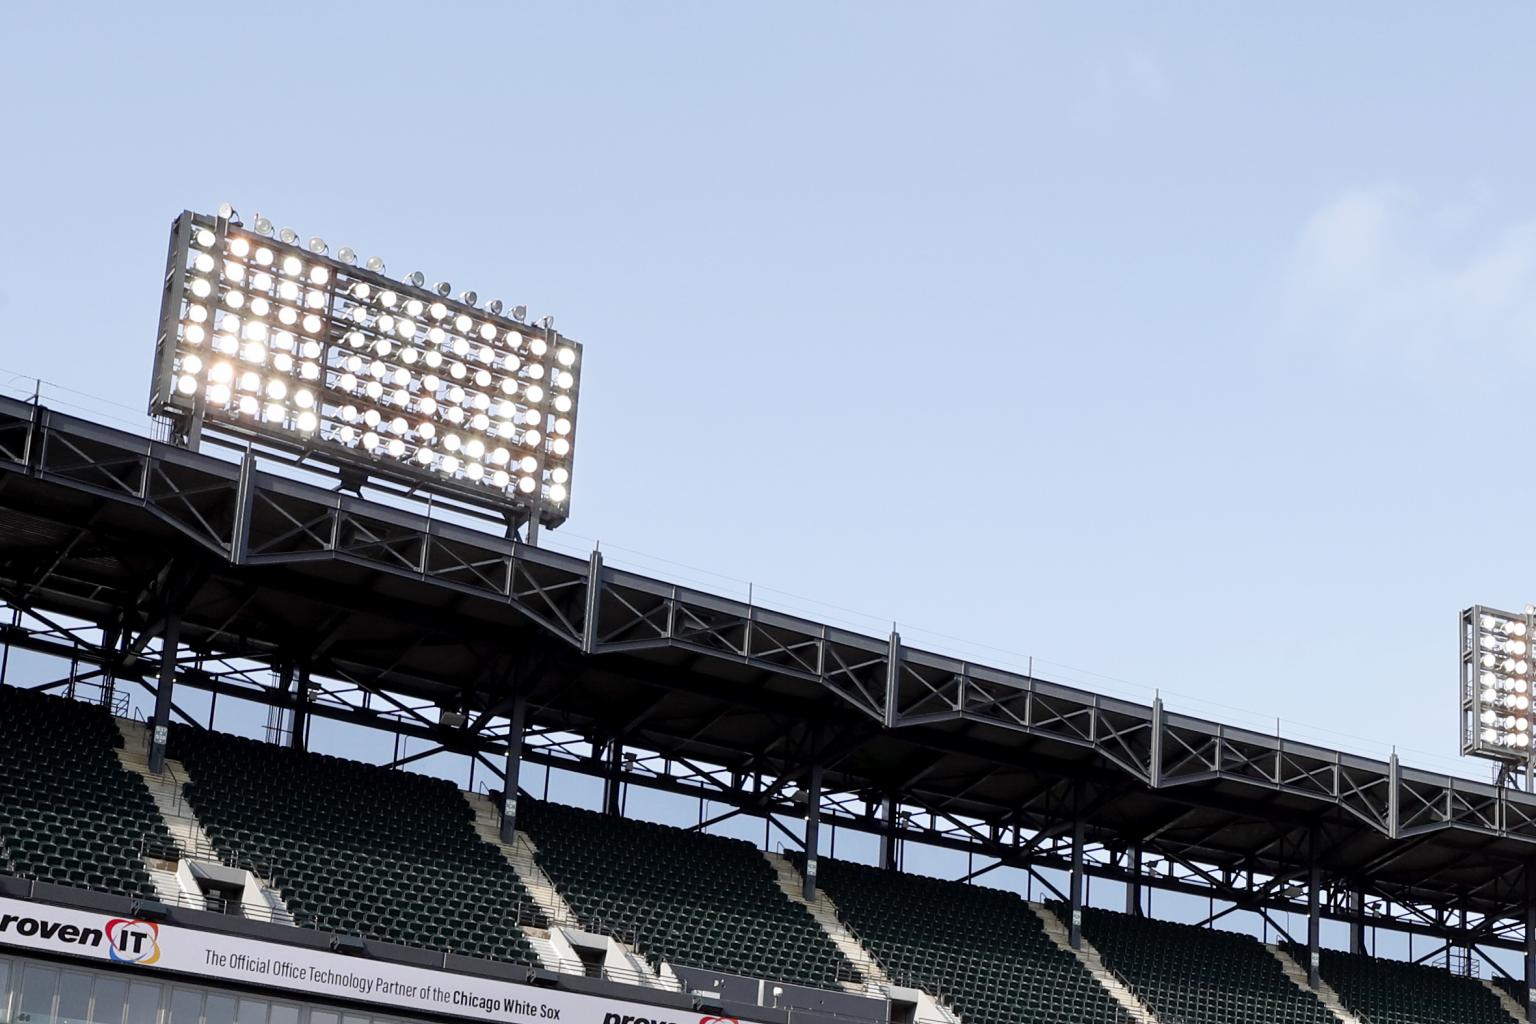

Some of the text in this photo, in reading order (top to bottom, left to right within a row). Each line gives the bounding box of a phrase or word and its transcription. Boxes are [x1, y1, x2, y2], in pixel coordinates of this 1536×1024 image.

[0, 914, 147, 954] roven IT
[205, 949, 561, 1020] The Official Office Technology Partner of the Chicago White Sox
